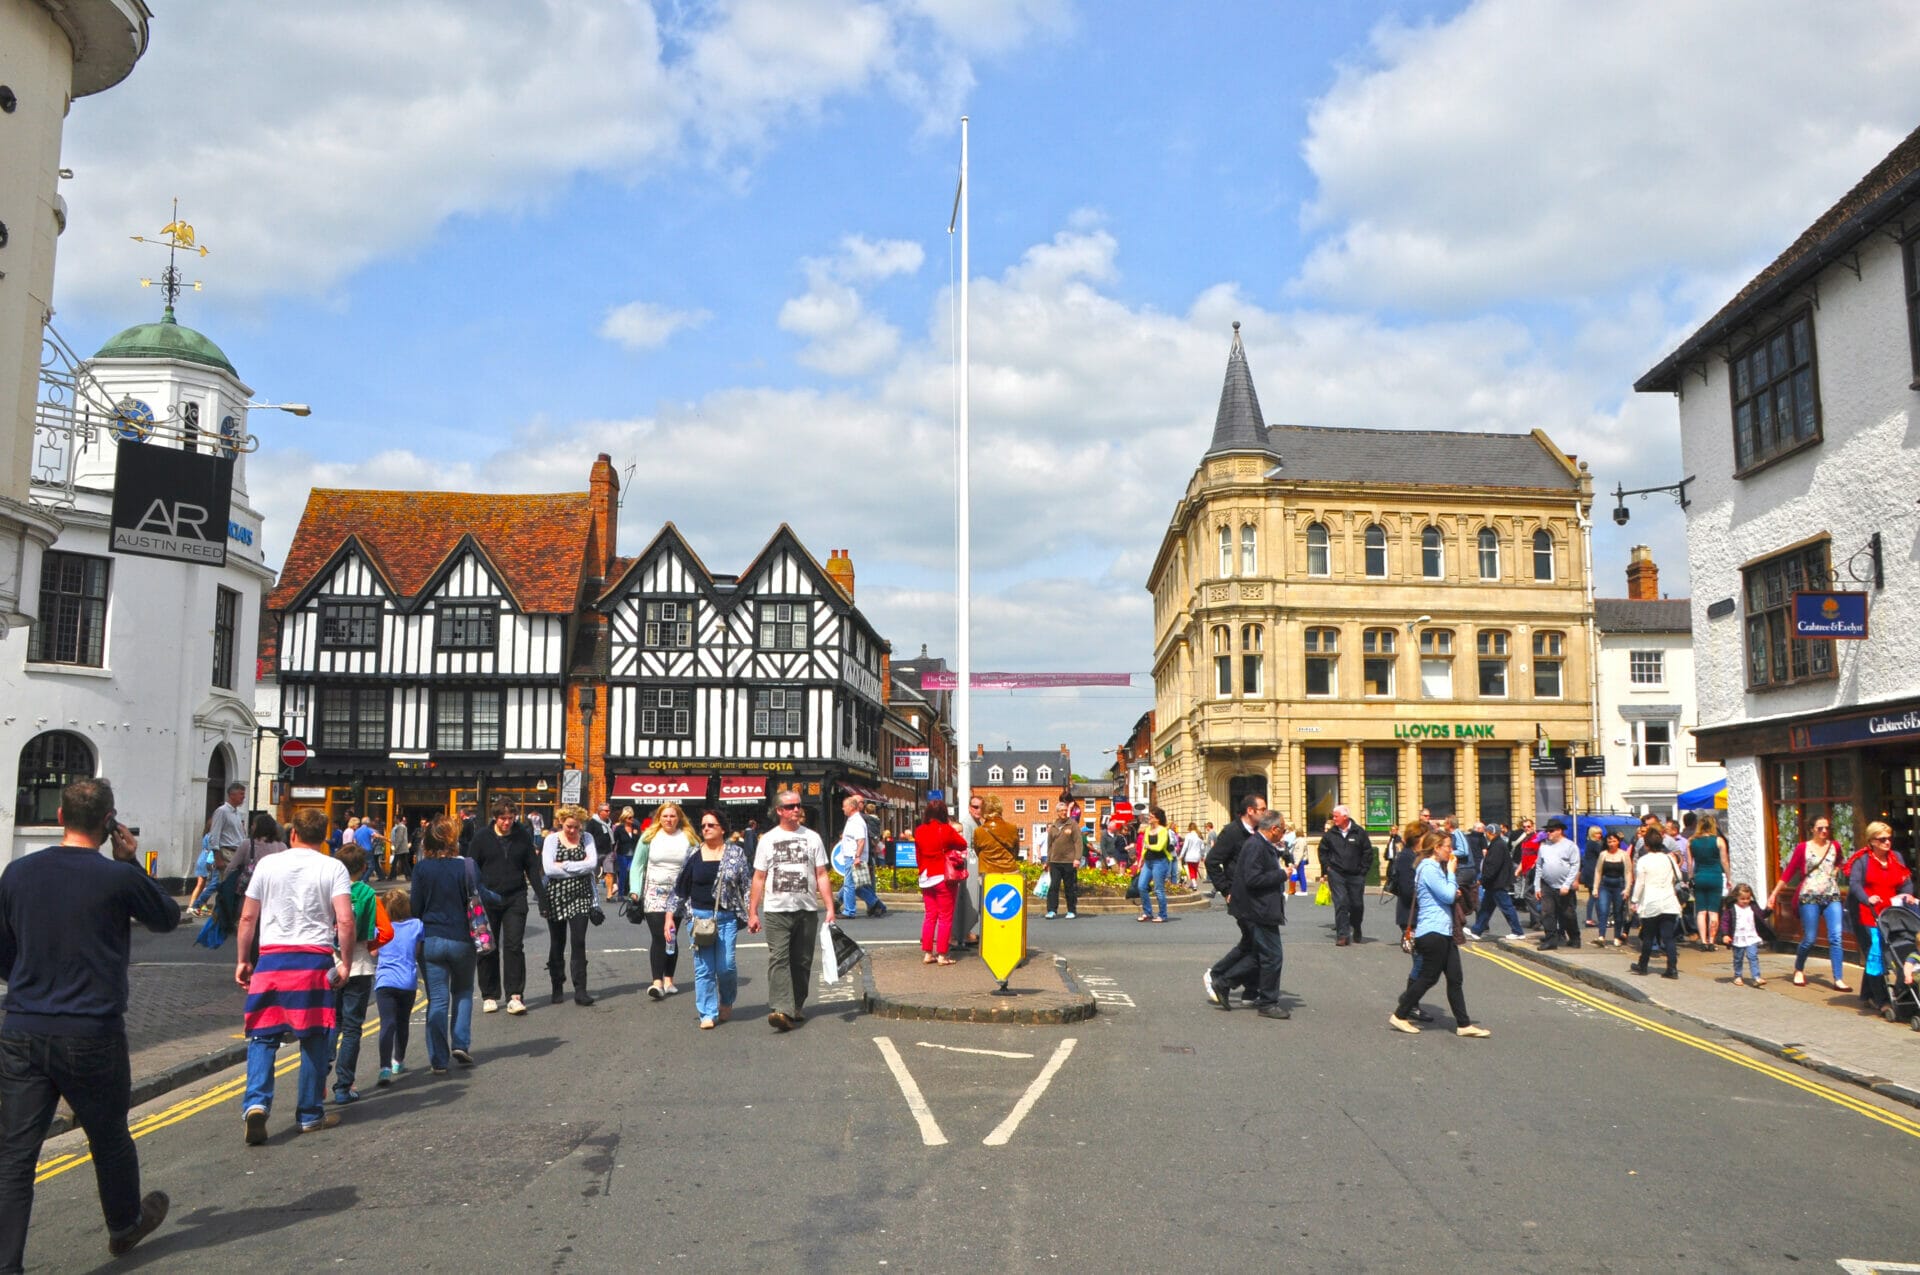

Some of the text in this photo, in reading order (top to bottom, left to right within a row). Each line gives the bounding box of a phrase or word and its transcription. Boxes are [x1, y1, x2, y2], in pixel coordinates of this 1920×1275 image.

[134, 499, 208, 541] AR
[115, 533, 223, 559] AUSTIN REED
[1394, 724, 1495, 738] LLOYDS BANK
[648, 761, 679, 770] COSTA
[762, 762, 793, 771] COSTA
[630, 782, 690, 795] COSTA
[722, 785, 763, 794] COSTA
